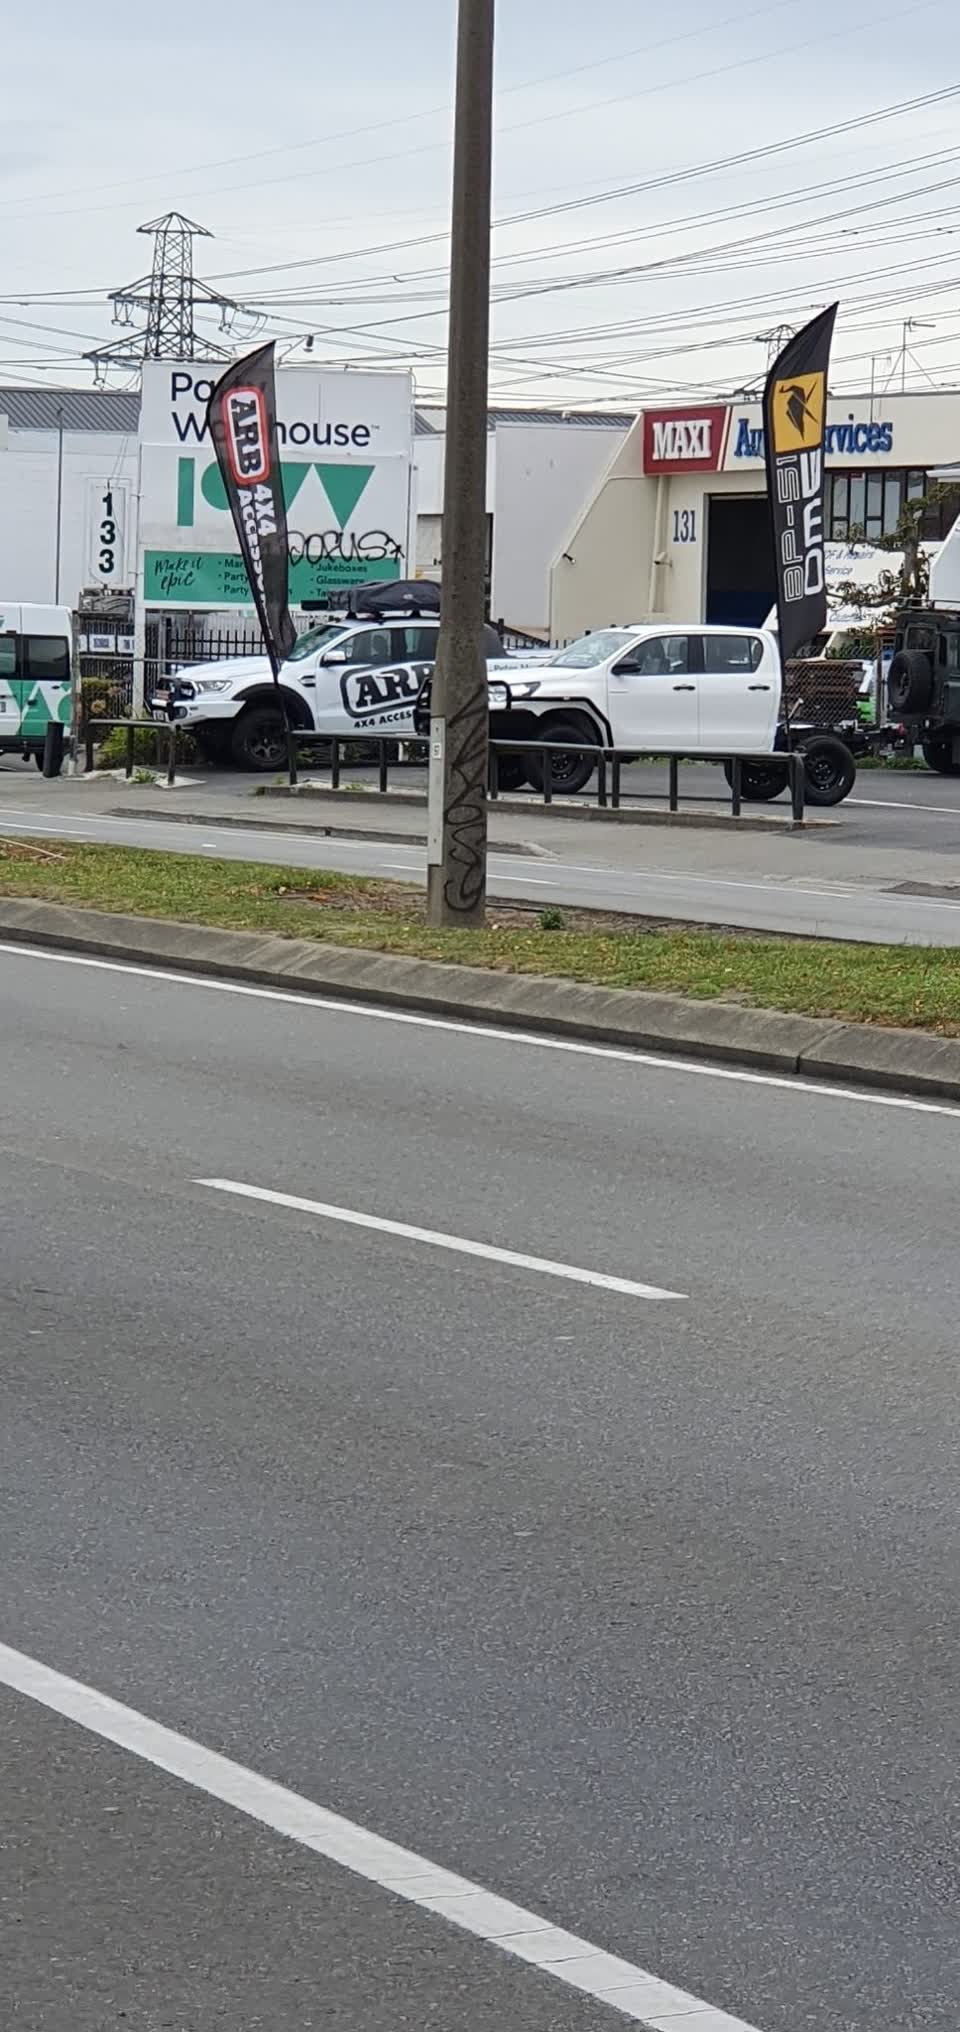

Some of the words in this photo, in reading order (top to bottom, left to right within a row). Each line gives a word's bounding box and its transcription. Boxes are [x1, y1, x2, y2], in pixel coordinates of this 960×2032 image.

[230, 398, 263, 475] ARB
[652, 419, 713, 461] MAXI
[825, 413, 893, 453] rvices
[98, 492, 116, 573] 133
[673, 509, 697, 543] 131
[776, 454, 804, 602] BP-51
[160, 571, 195, 597] epic
[316, 563, 368, 573] Jukeboxes
[354, 717, 376, 729] 4X4
[379, 710, 412, 725] ACCES
